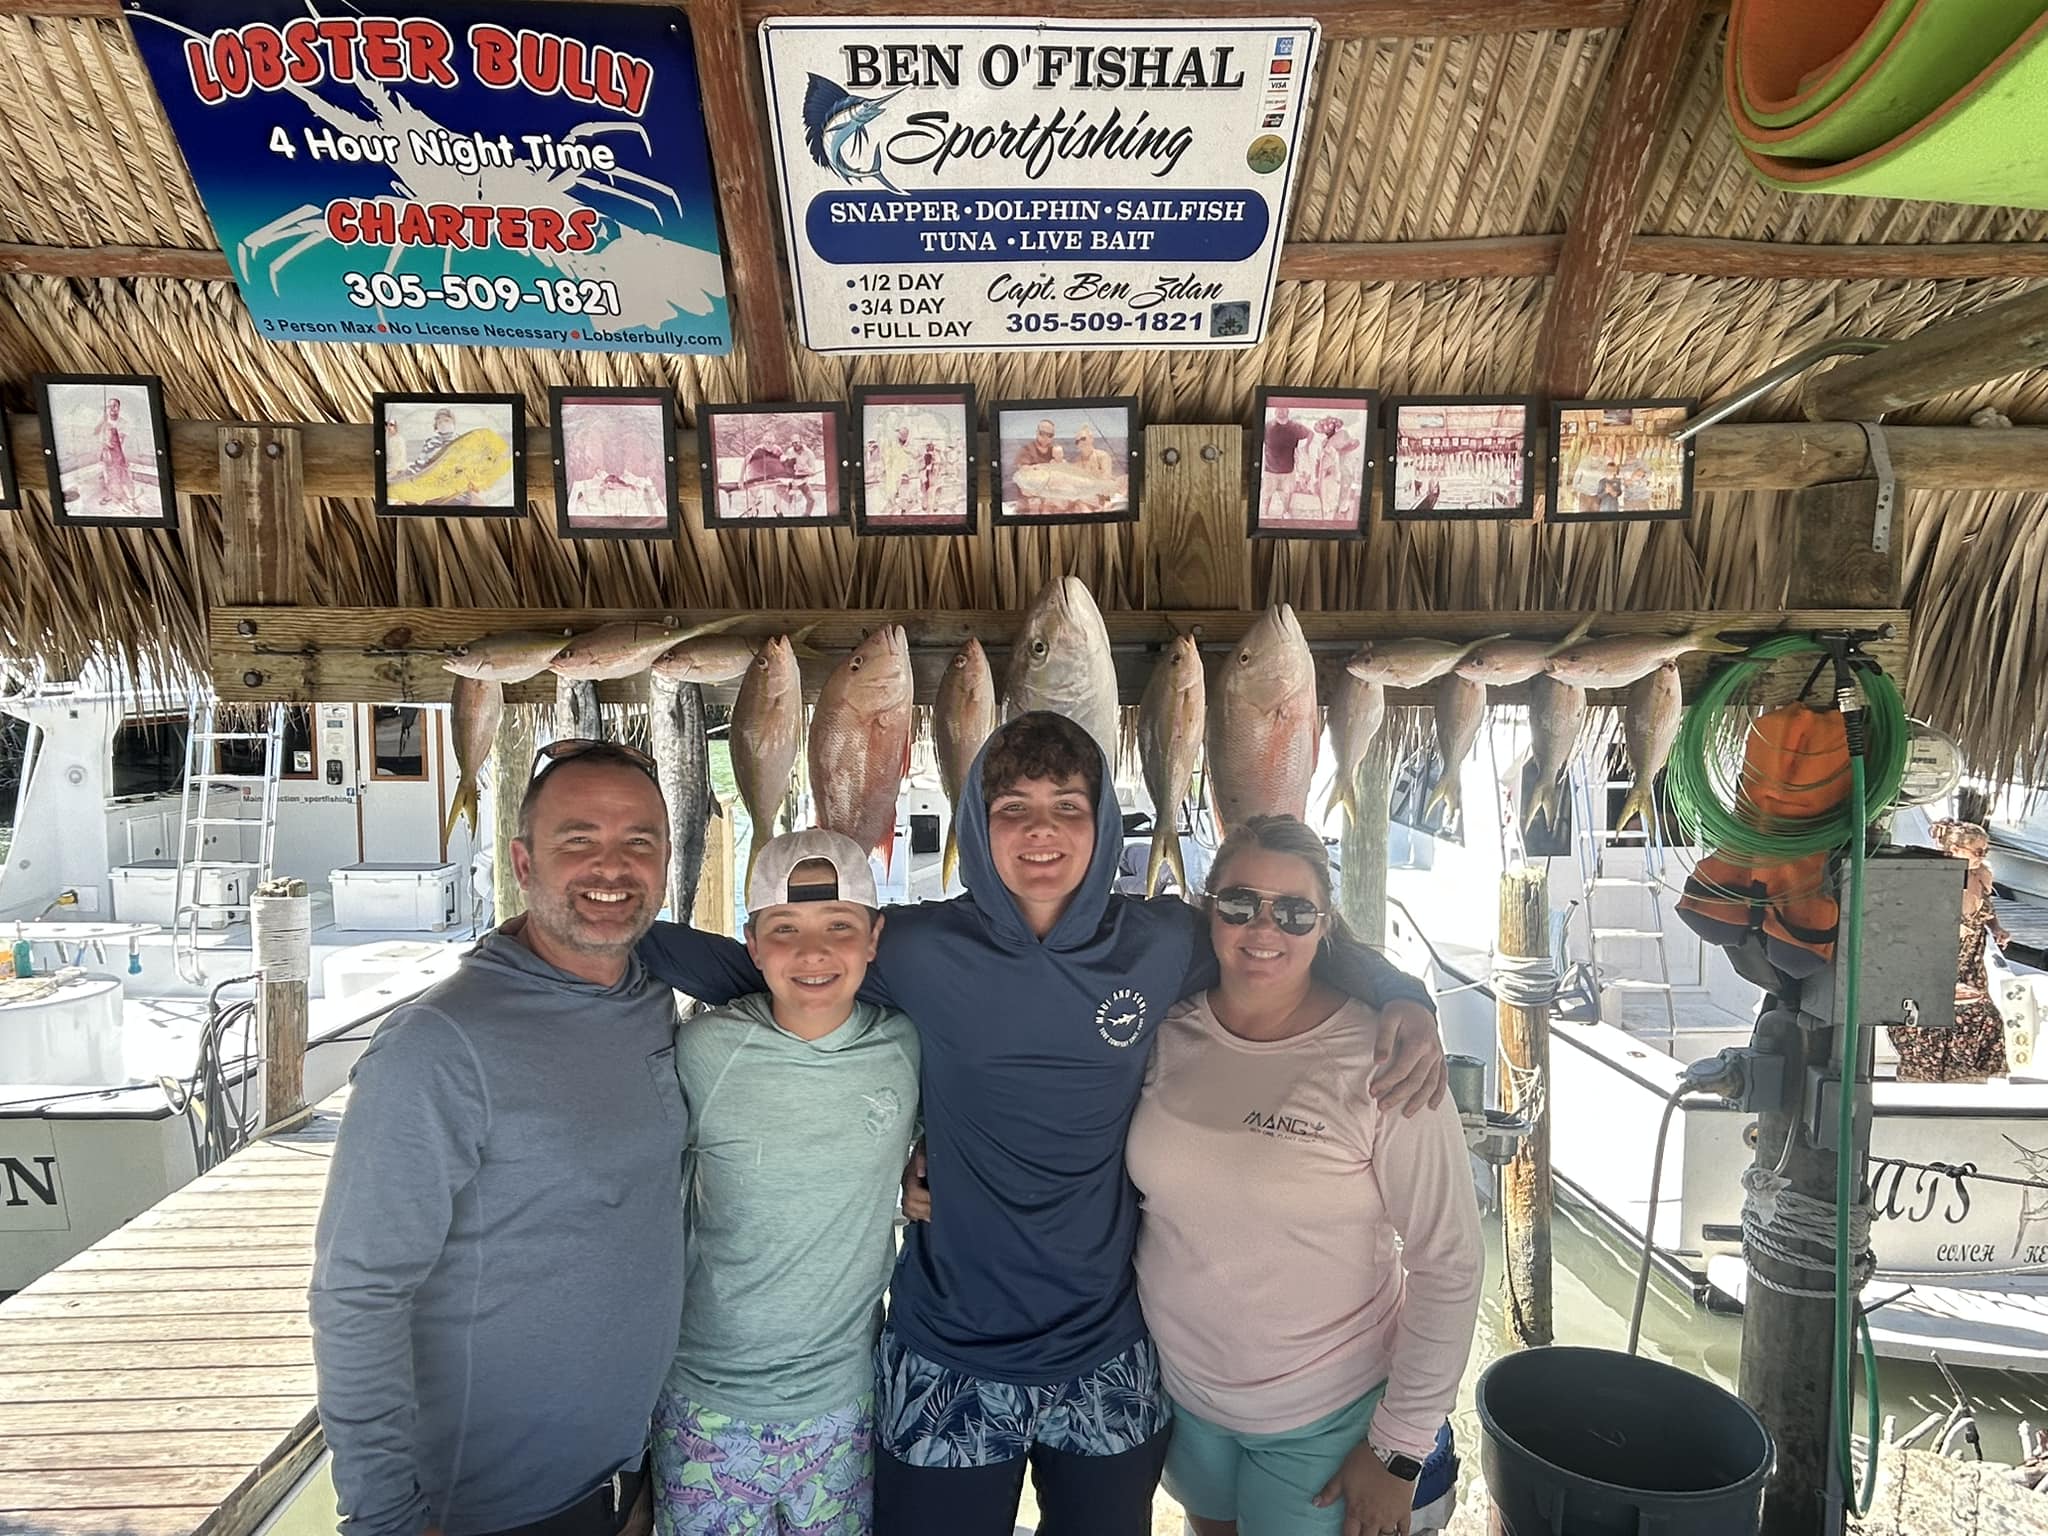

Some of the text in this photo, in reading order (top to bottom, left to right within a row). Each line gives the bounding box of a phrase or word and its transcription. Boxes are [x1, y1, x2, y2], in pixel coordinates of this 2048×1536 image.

[185, 18, 653, 116] LOBSTER BULLY
[842, 44, 1245, 91] BEN O'FISHAL
[1270, 81, 1288, 89] VISA
[269, 126, 616, 175] 4 Hour Night Time
[887, 107, 1193, 180] Sportfishing
[830, 200, 1245, 223] SNAPPER DOLPHIN SAILFISH
[325, 200, 601, 252] CHARTERS
[920, 231, 1155, 252] TUNA LIVE BAIT
[858, 273, 945, 292] 1/2 DAY
[987, 273, 1057, 309] Capt.
[1063, 274, 1130, 302] Ben
[343, 272, 621, 317] 305-509-1821
[861, 298, 945, 316] 3/4 DAY
[263, 318, 376, 334] 3 Person Max
[389, 322, 568, 343] No License Necessary
[863, 320, 972, 339] FULL DAY
[1006, 312, 1204, 334] 305-509-1821
[582, 328, 723, 347] Lobsterbully.com
[1112, 989, 1131, 1001] AND
[1937, 1243, 1995, 1263] CONCH
